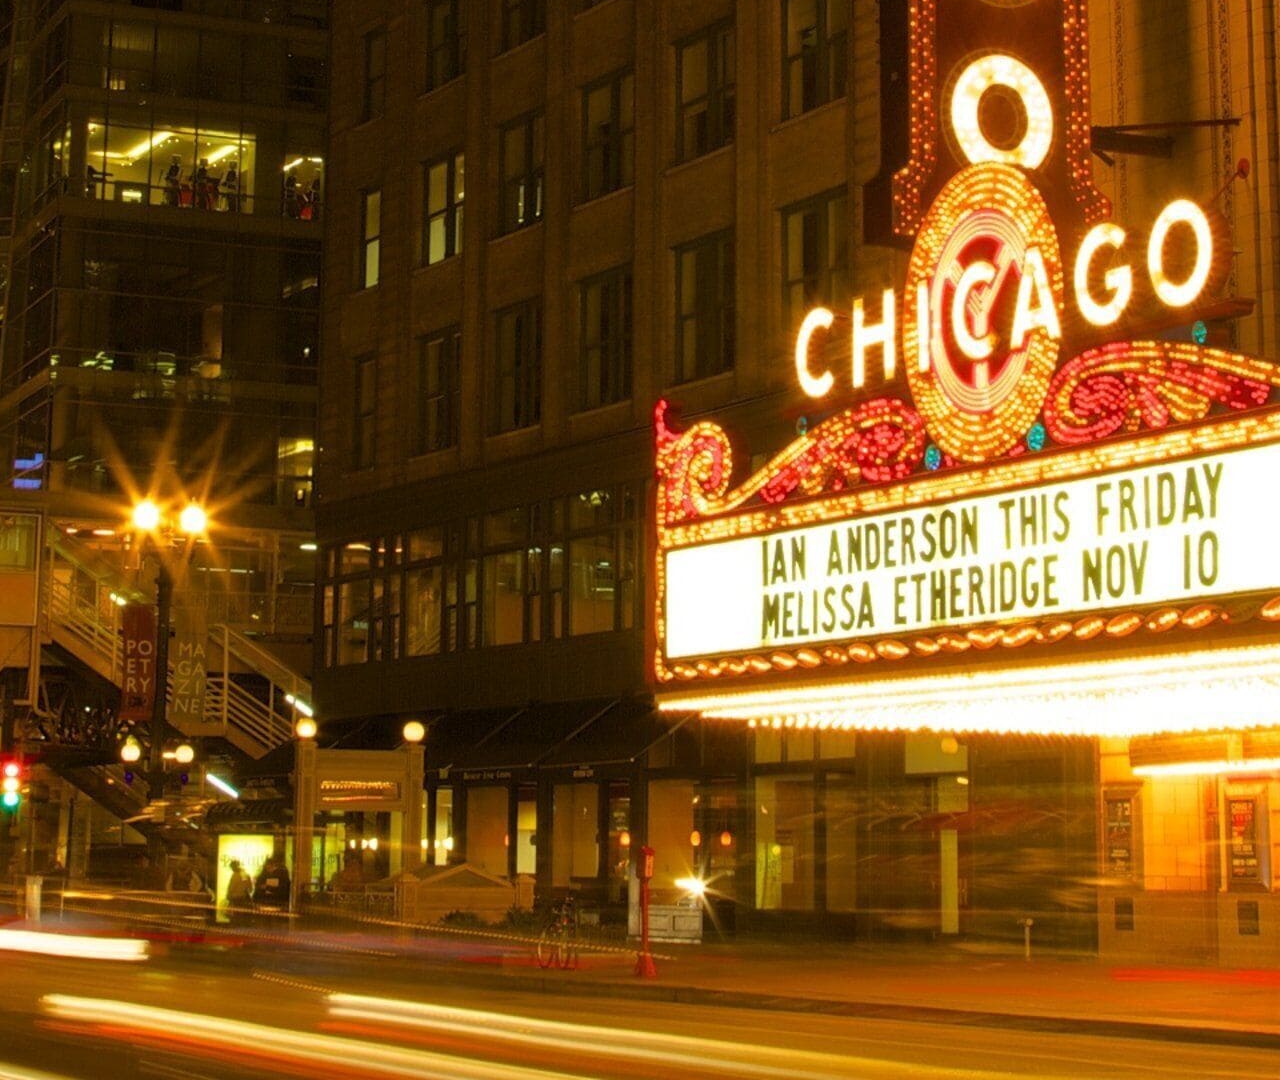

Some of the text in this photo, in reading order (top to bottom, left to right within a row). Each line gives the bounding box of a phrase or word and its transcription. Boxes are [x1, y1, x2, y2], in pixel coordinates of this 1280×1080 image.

[794, 198, 1214, 397] CHICAGO
[762, 462, 1225, 583] IAN ANDERSON THIS FRIDAY
[762, 531, 1219, 640] MELISSA ETHERIDGE NOV 10
[127, 639, 153, 655] PO
[179, 643, 206, 658] MA
[127, 658, 151, 675] ET
[177, 660, 205, 677] GA
[126, 678, 150, 693] RY
[176, 680, 201, 696] ZI
[175, 698, 200, 713] NE
